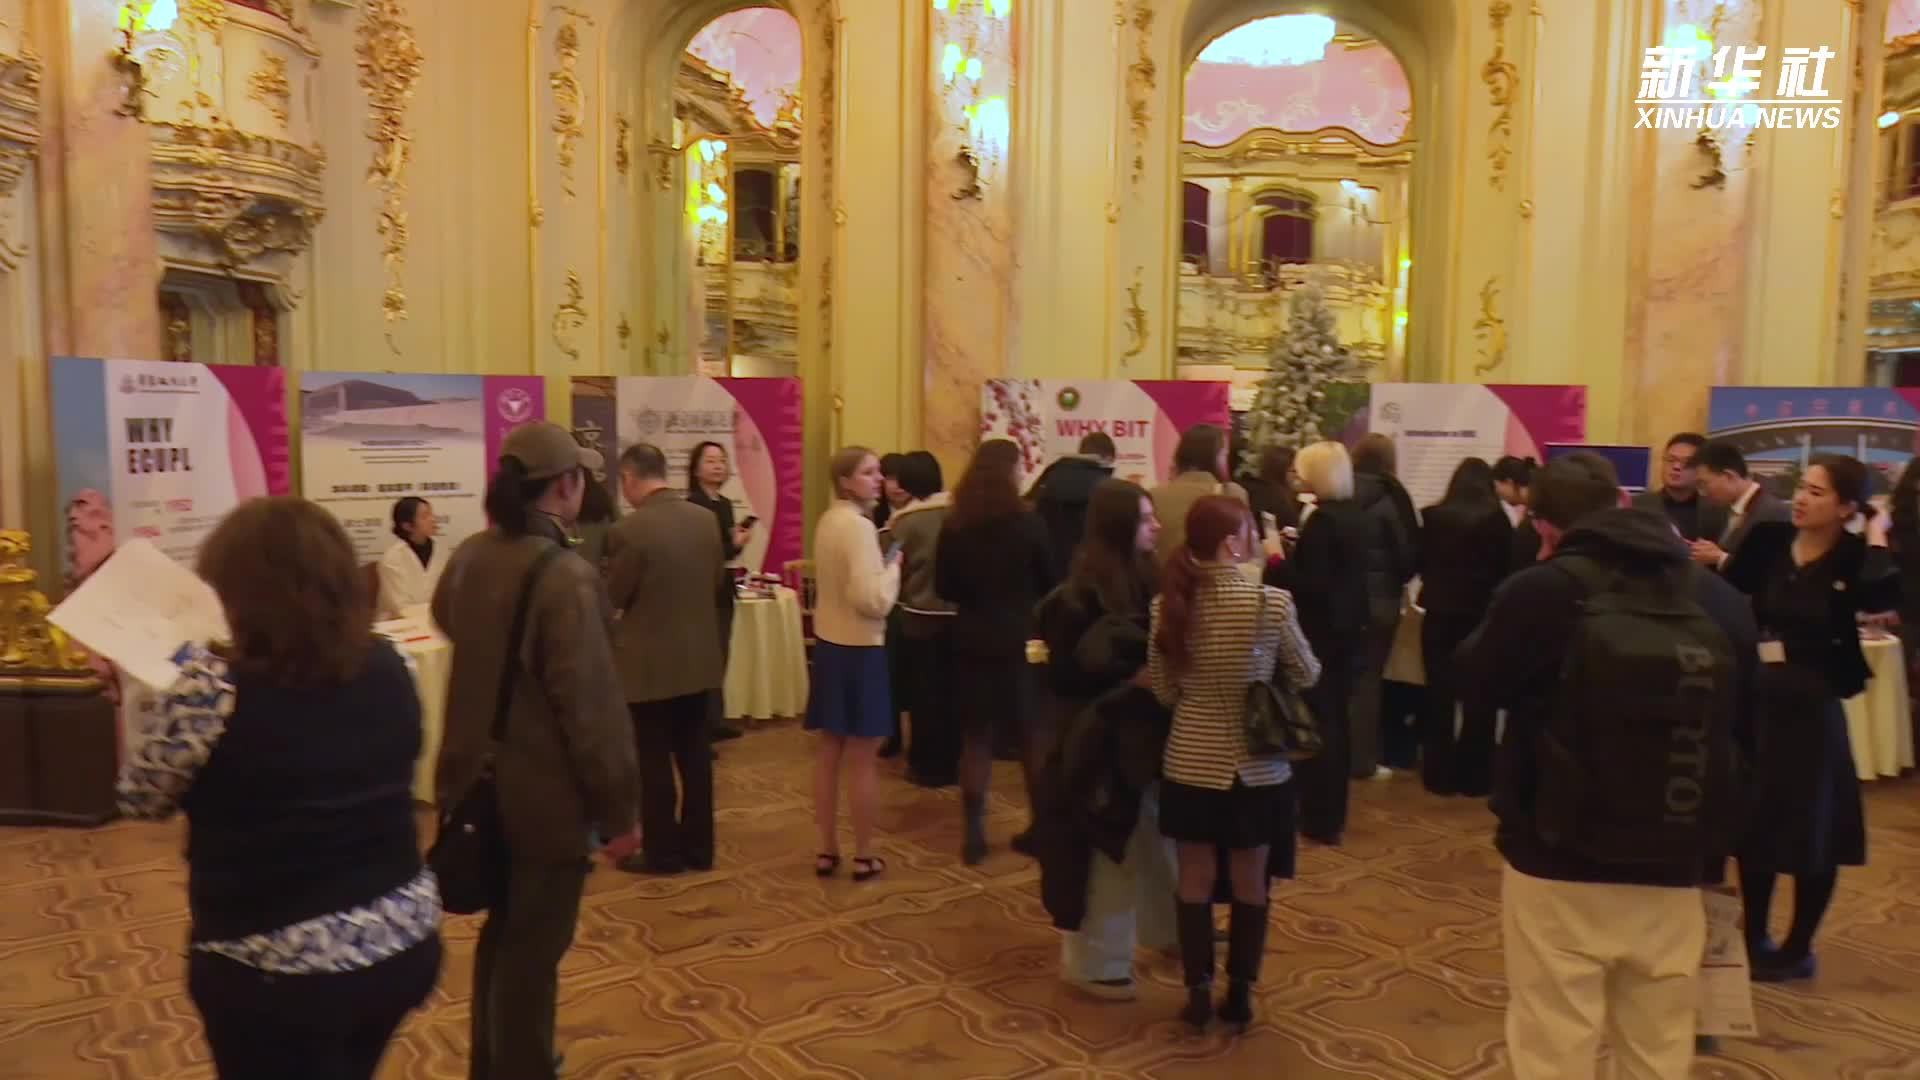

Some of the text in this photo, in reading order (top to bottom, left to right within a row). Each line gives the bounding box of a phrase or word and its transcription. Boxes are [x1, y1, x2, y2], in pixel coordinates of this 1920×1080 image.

[125, 417, 173, 443] WHY
[1056, 419, 1150, 437] WHY BIT
